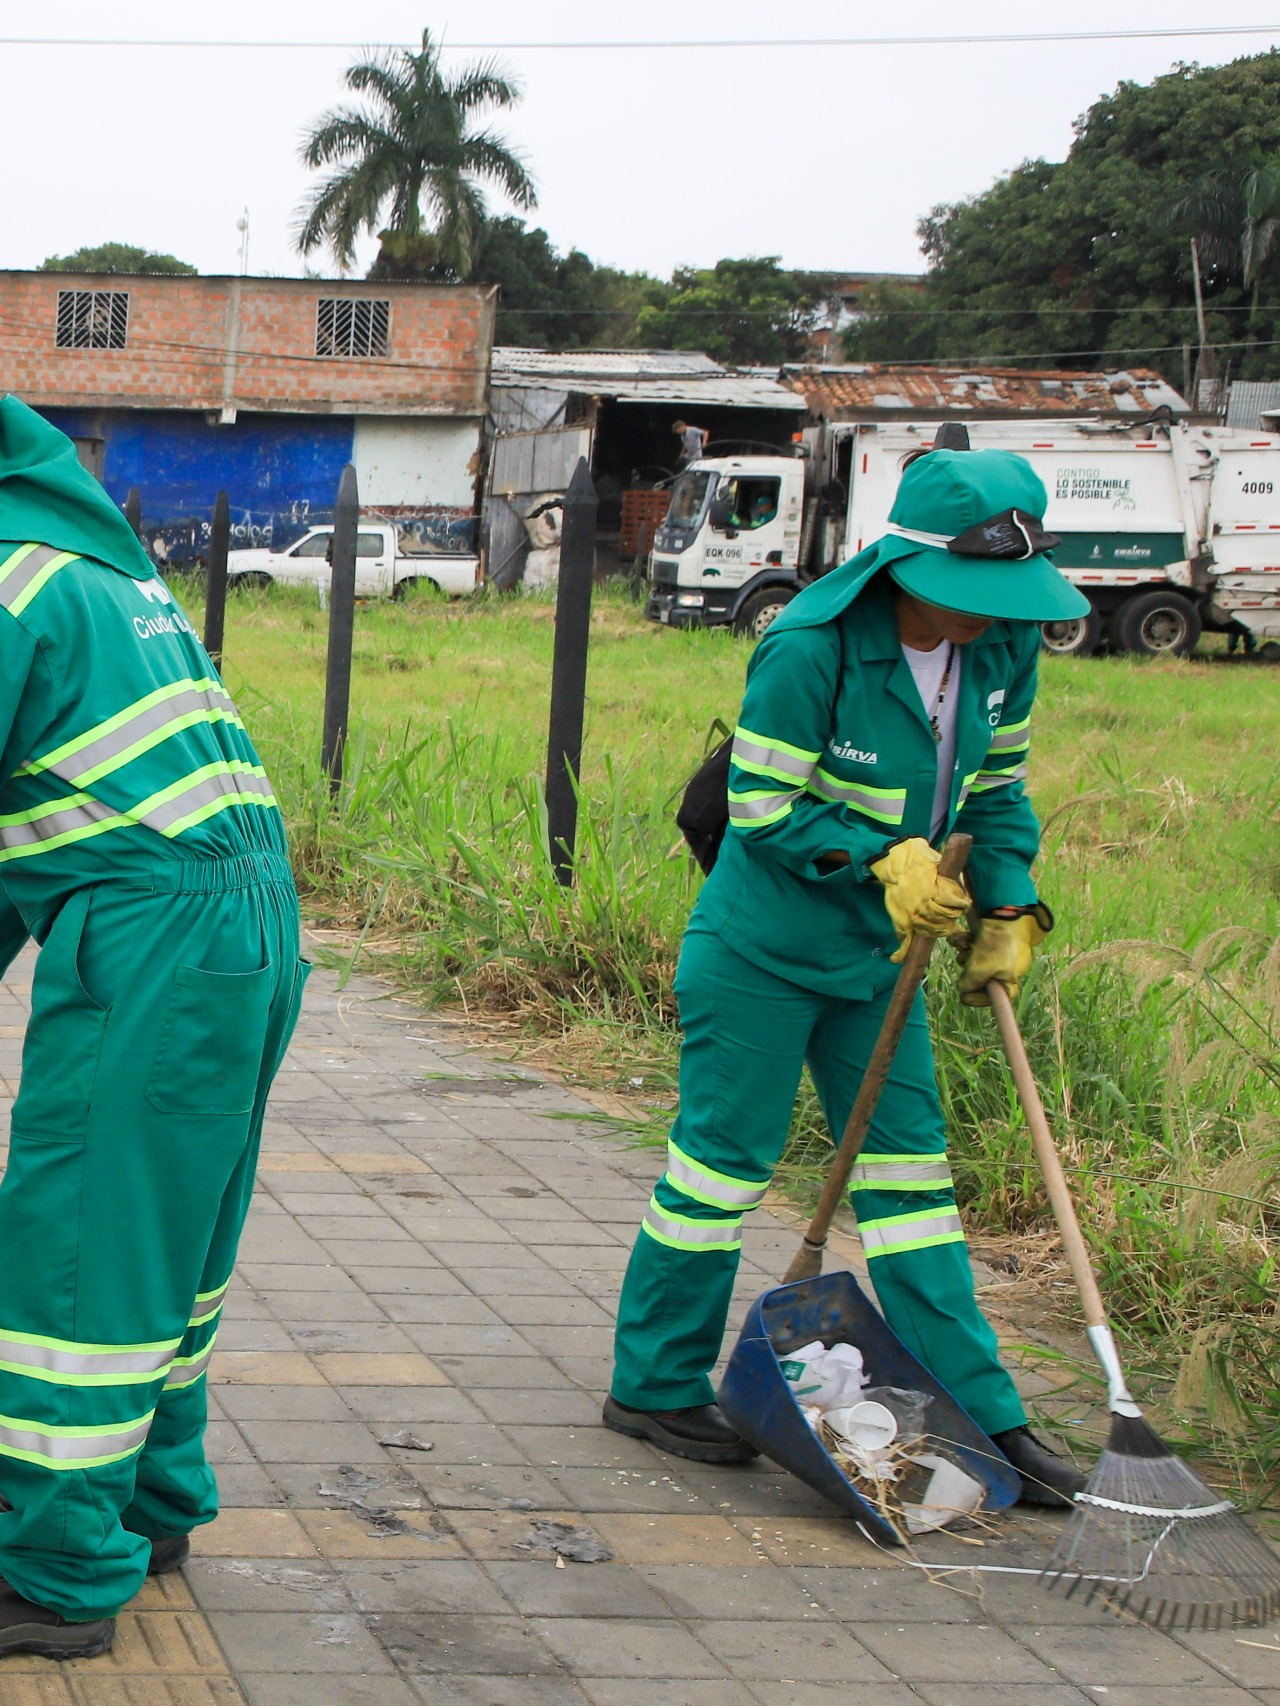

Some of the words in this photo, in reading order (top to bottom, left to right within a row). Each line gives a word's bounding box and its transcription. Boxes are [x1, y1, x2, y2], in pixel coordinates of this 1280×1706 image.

[1057, 468, 1100, 479] CONTIGO
[1056, 479, 1069, 489] LO
[1072, 479, 1130, 489] SOSTENIBLE
[1241, 482, 1273, 494] 4009
[1056, 489, 1068, 499] ES
[1071, 489, 1112, 499] POSIBLE
[706, 547, 723, 558] EQK
[725, 548, 741, 558] 096
